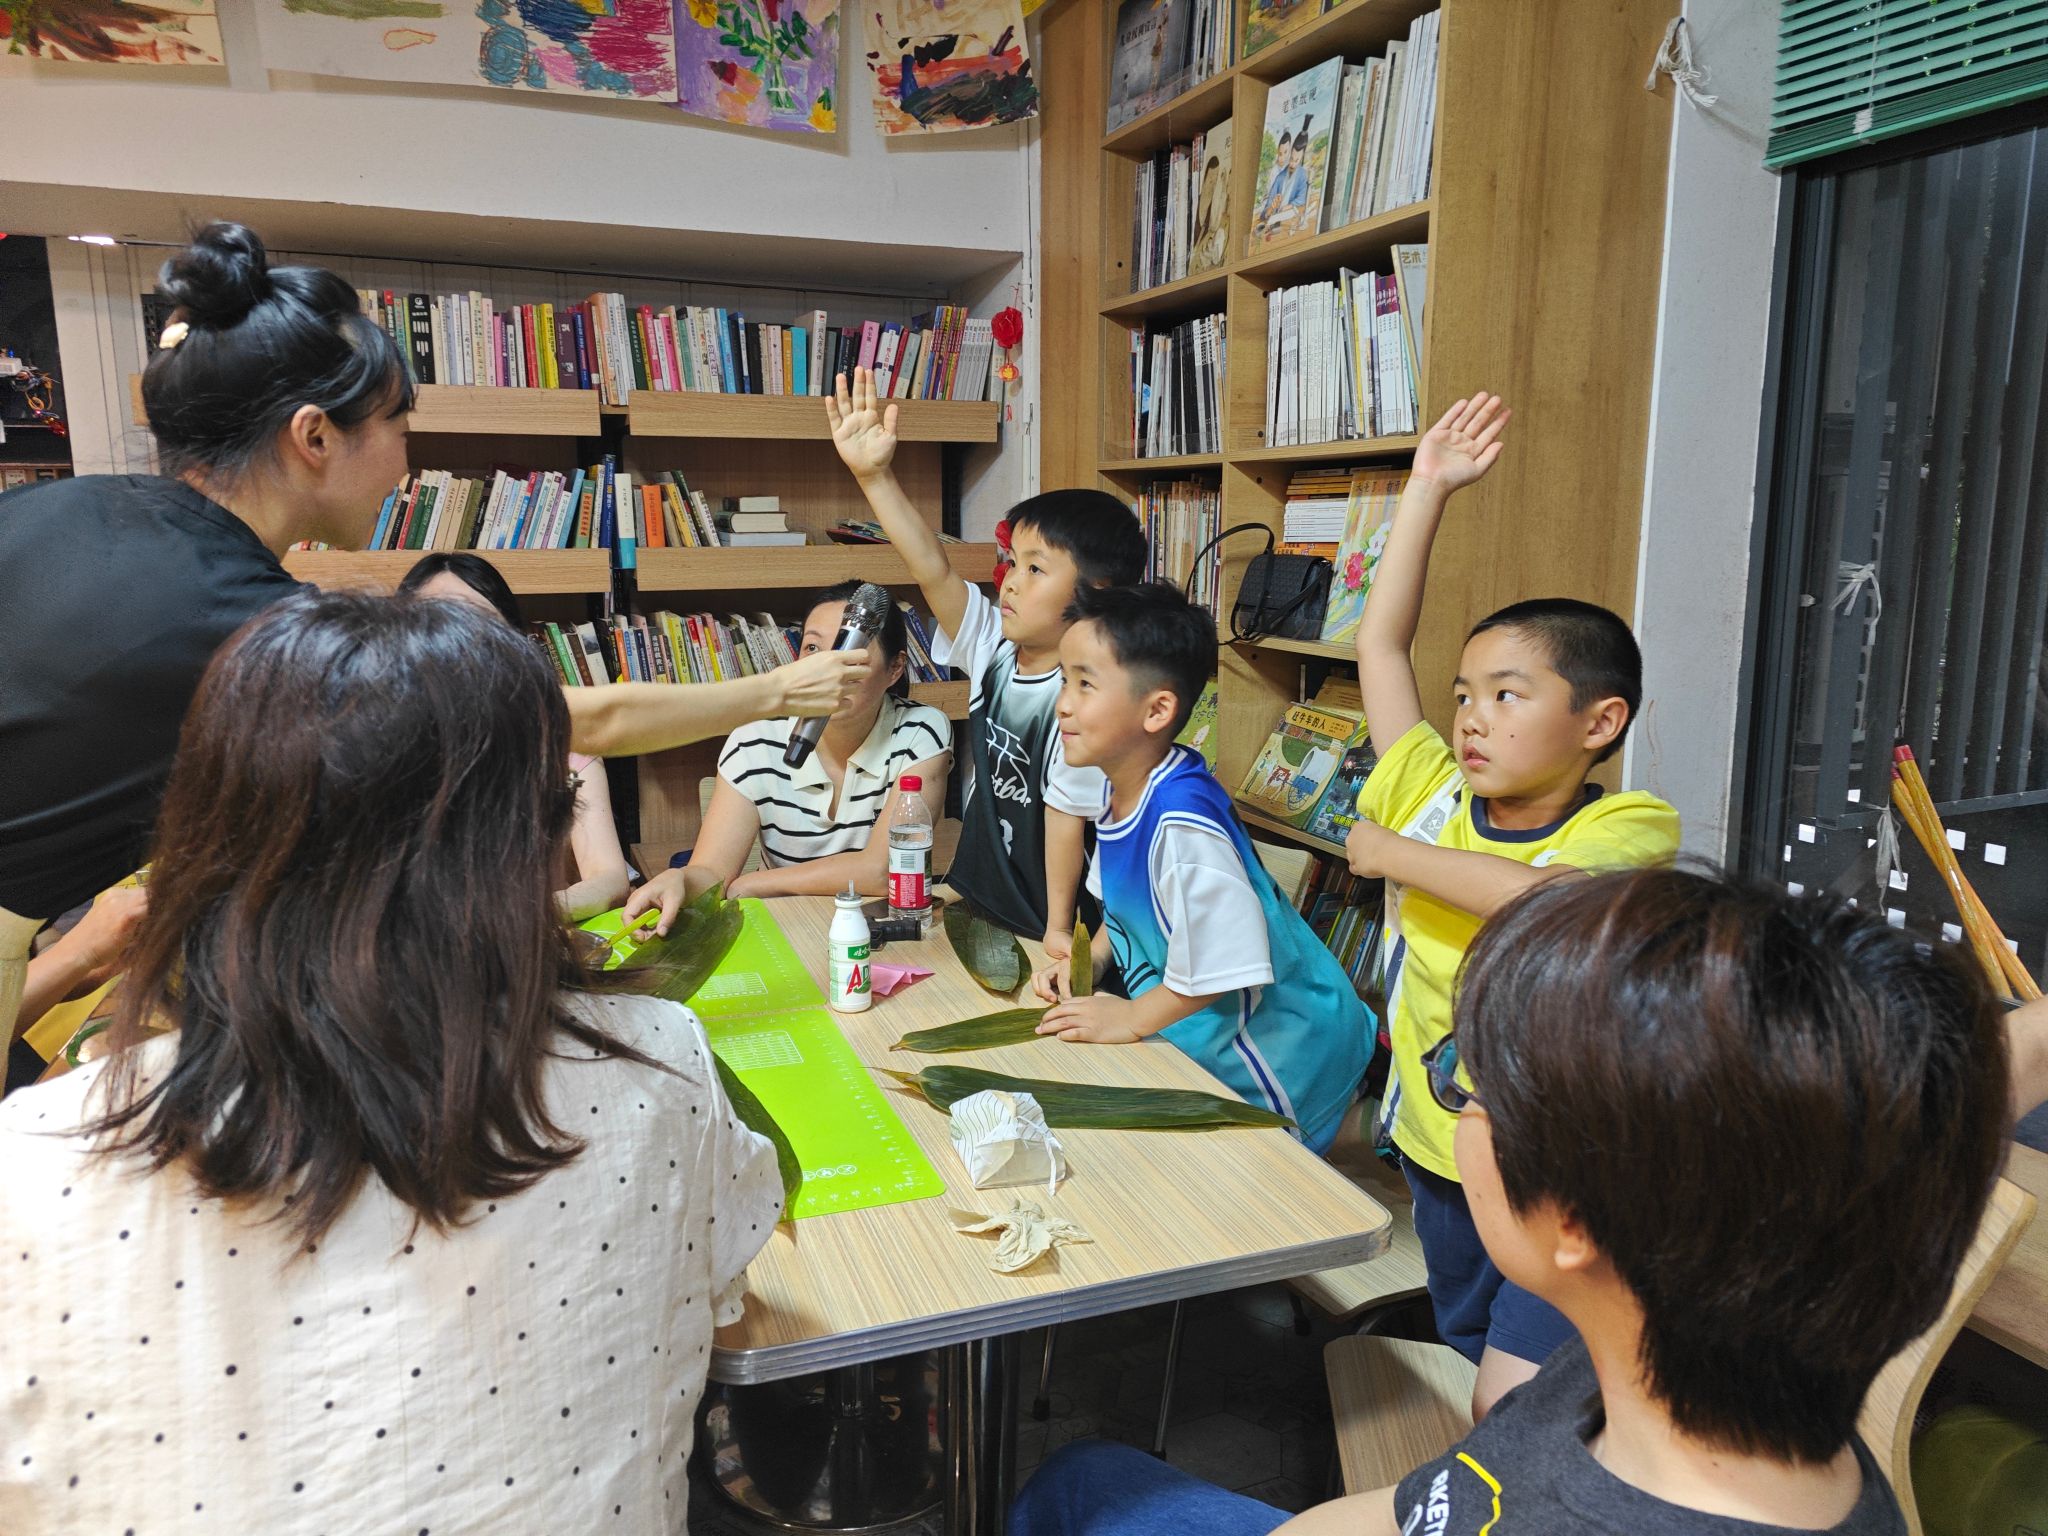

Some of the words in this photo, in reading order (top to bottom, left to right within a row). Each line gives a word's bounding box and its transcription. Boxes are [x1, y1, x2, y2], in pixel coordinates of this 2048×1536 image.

[1292, 711, 1326, 730] 赶牛车的人
